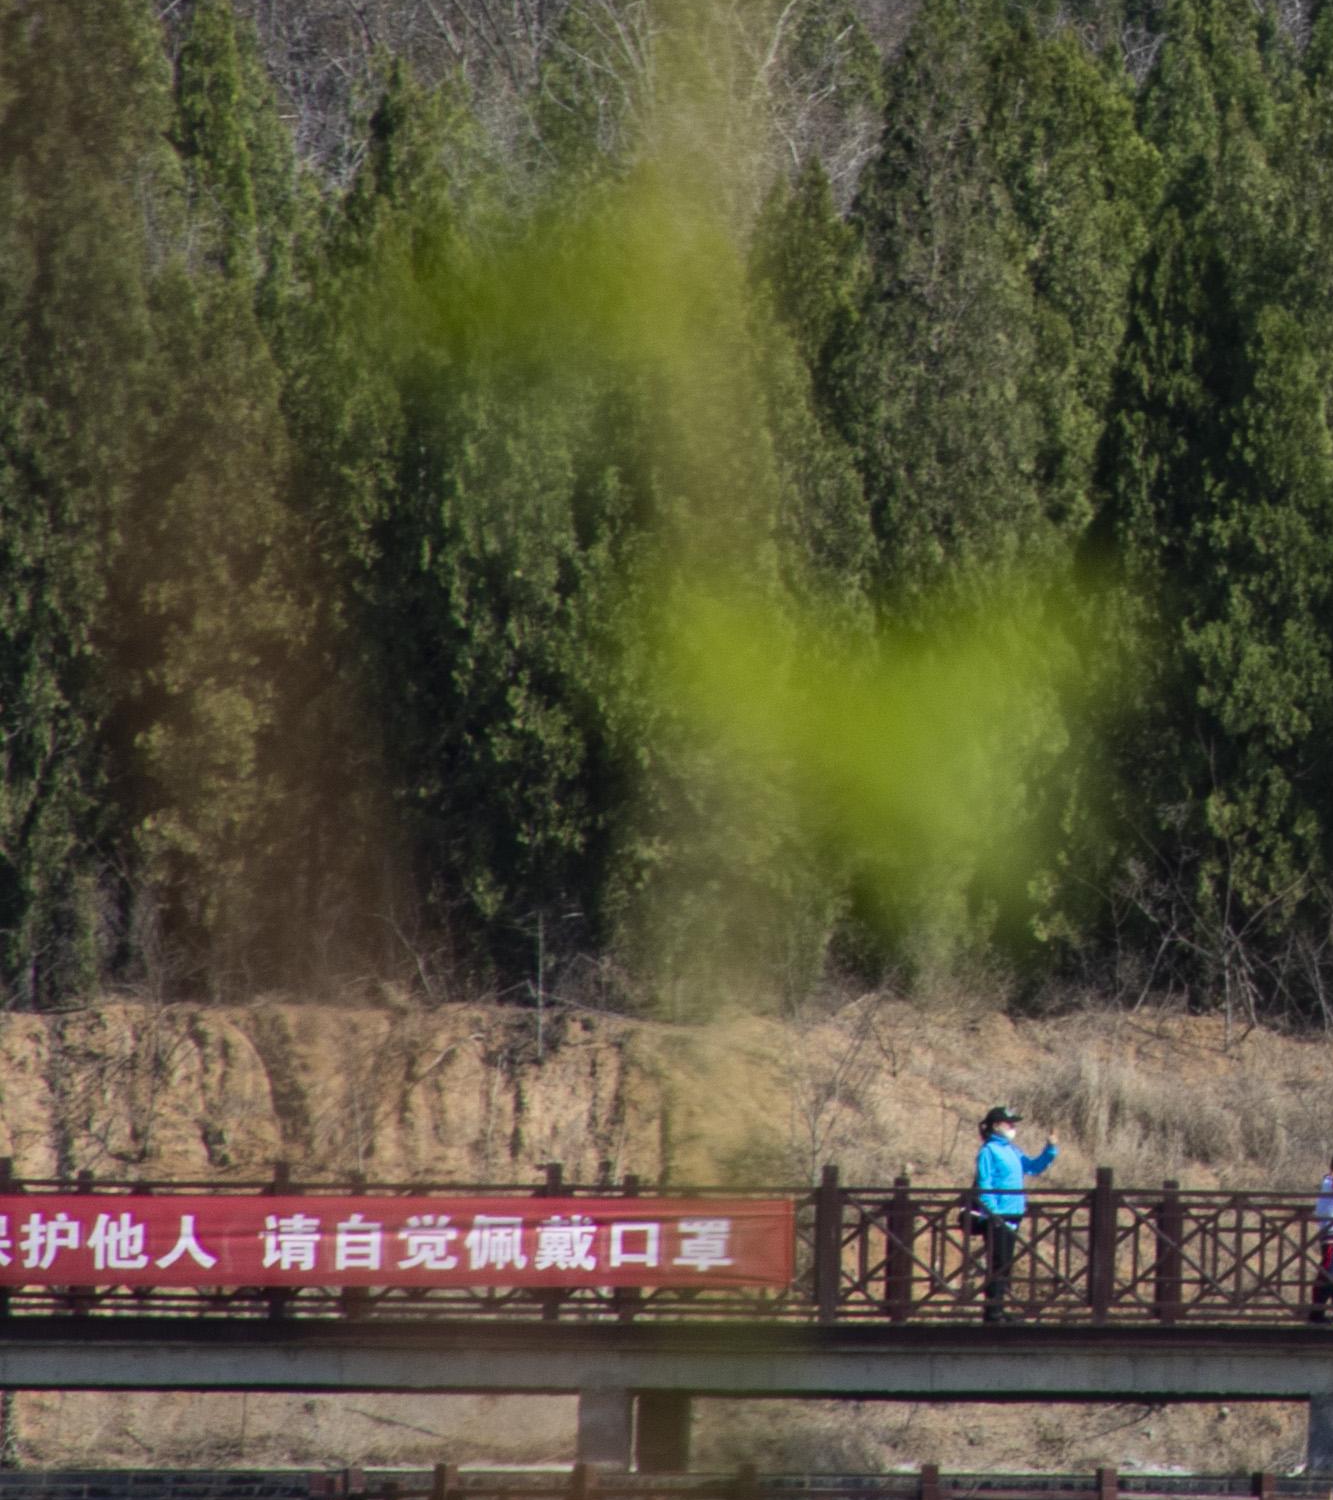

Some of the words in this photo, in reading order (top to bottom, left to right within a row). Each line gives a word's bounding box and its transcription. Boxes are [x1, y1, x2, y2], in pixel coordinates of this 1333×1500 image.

[0, 1212, 218, 1270] 护他人
[260, 1213, 736, 1272] 请自觉佩戴口罩
